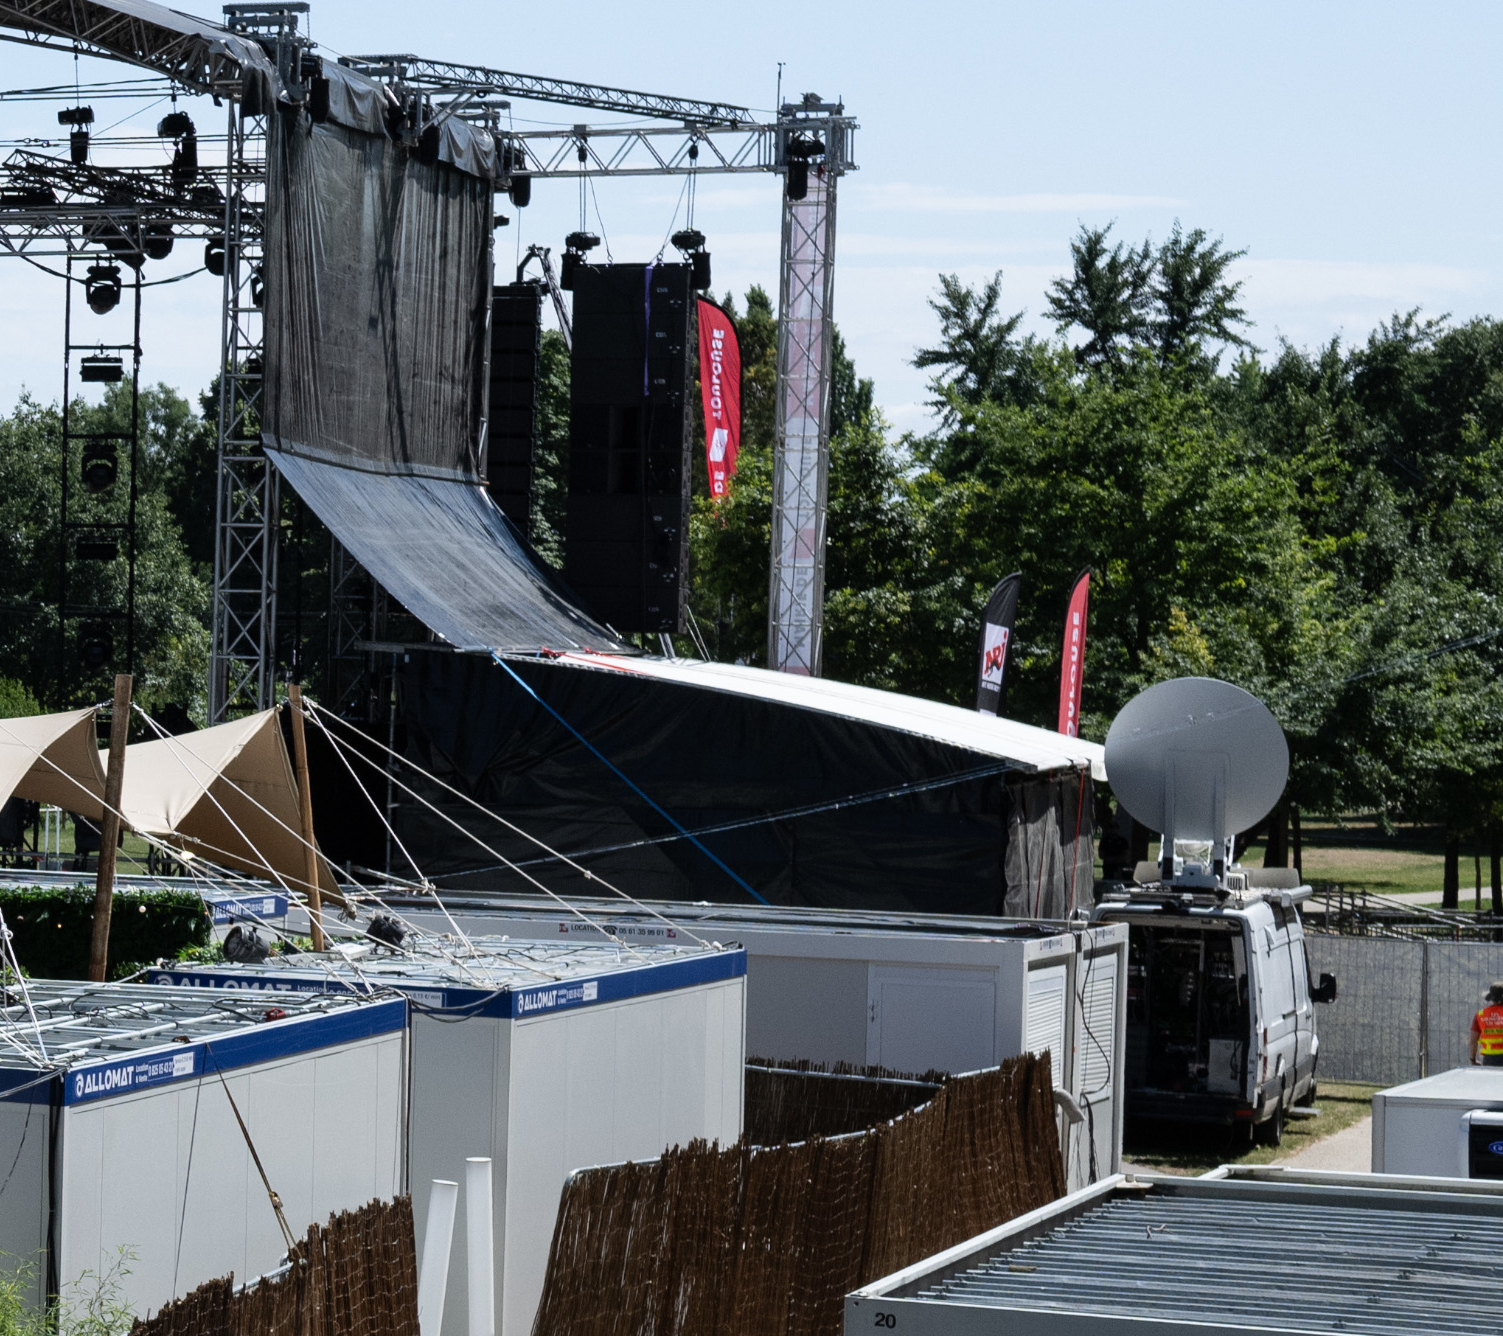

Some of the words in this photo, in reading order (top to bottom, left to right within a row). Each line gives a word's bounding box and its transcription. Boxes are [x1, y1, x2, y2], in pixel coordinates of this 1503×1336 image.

[524, 990, 558, 1011] ALLOMAT
[84, 1066, 134, 1094] ALLOMAT
[874, 1312, 896, 1329] 20
